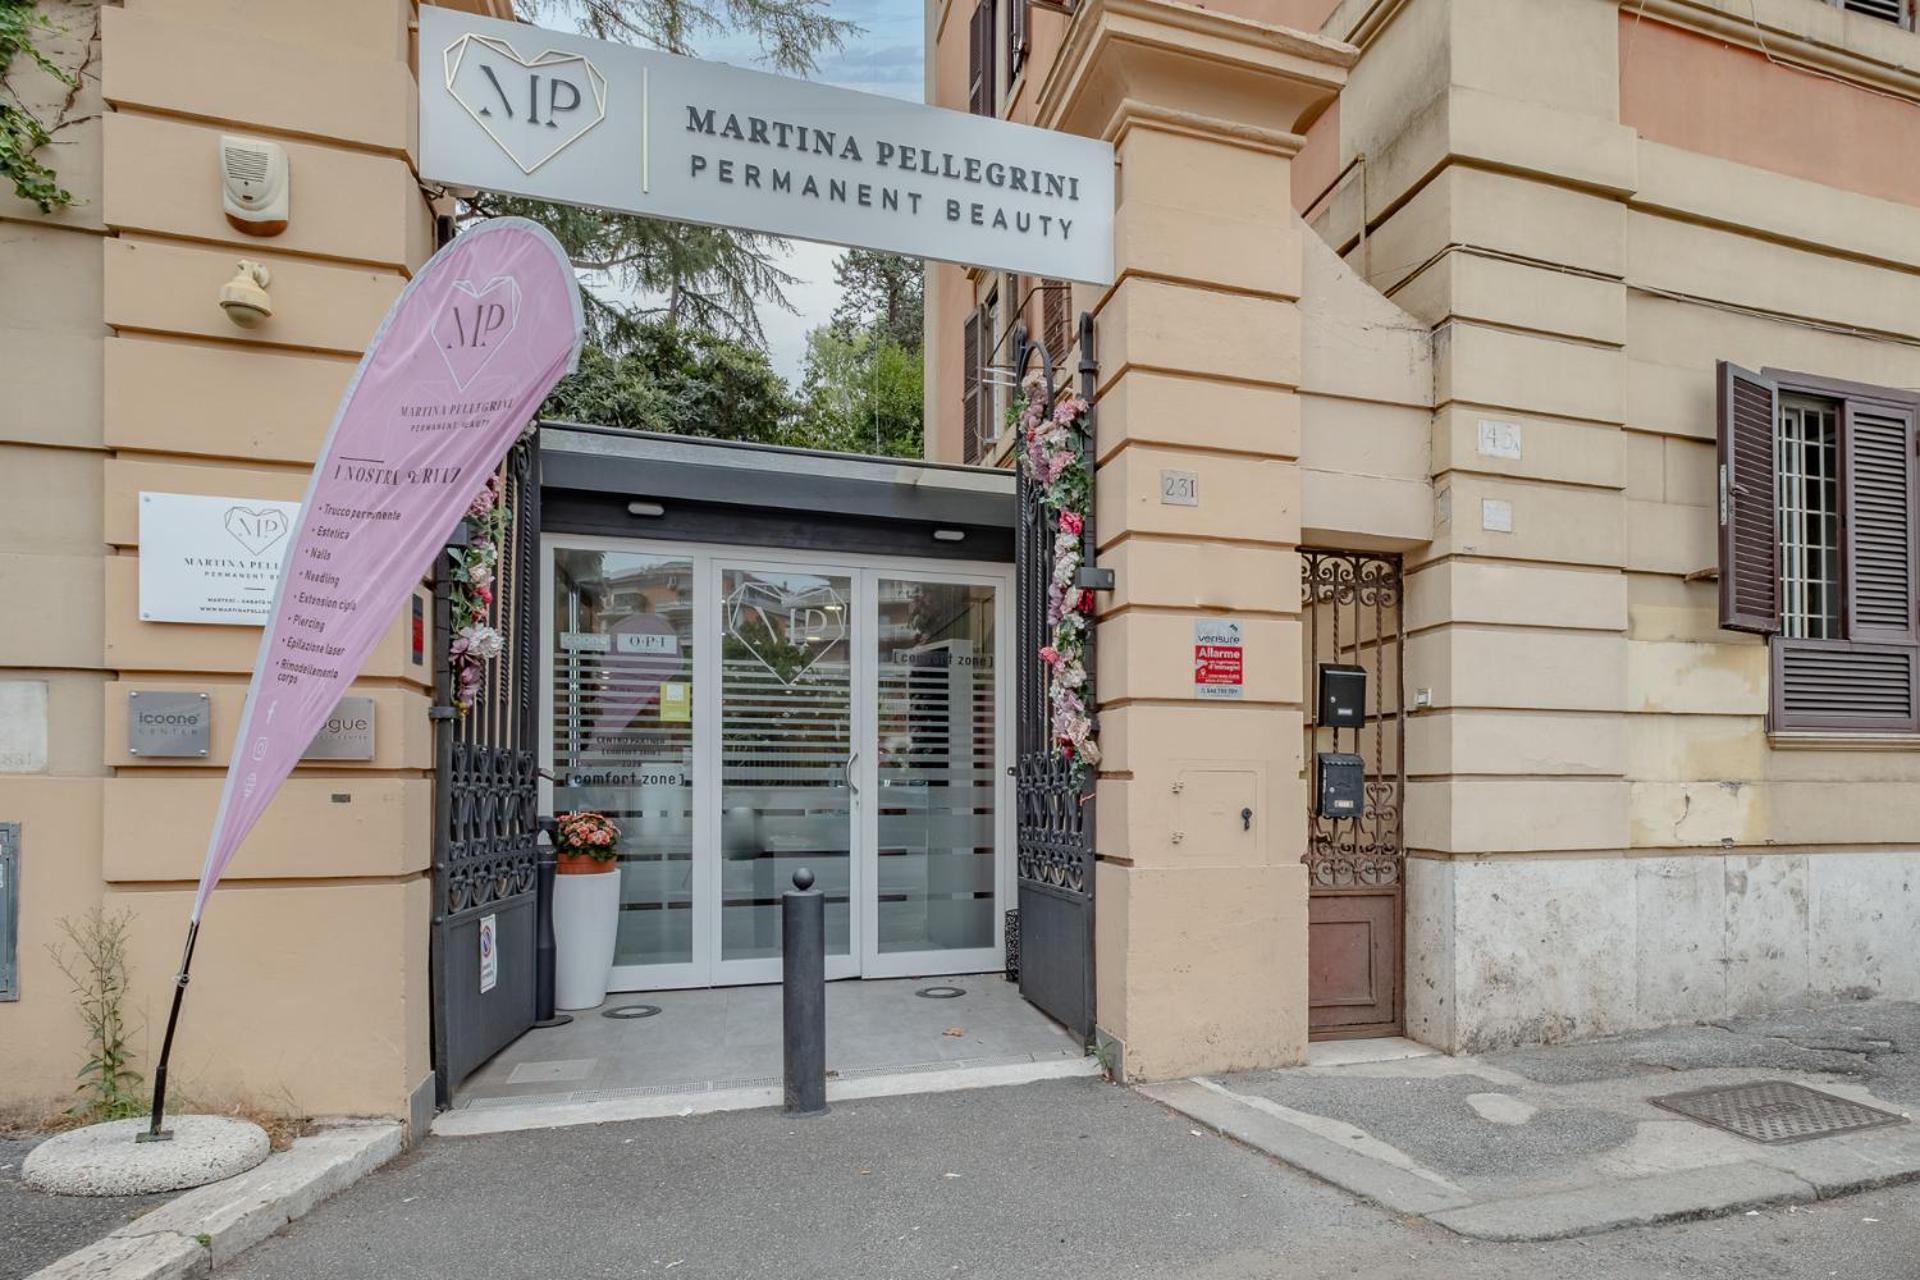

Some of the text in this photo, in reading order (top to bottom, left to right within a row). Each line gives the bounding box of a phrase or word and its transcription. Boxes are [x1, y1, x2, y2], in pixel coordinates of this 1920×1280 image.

[686, 105, 1081, 201] MARTINA PELLEGRINI
[691, 155, 1074, 240] PERMANENT BEAUTY
[1165, 476, 1195, 498] 231
[324, 503, 350, 517] Trucco
[316, 525, 350, 540] Estetica
[310, 547, 332, 560] Nails
[184, 557, 245, 569] MARTINA
[204, 571, 264, 580] PERMANENT
[304, 570, 341, 588] Needling
[298, 592, 338, 609] Extension
[293, 614, 326, 633] Piercing
[286, 636, 346, 656] Epilazione laser
[1197, 635, 1241, 644] verisure
[1199, 646, 1241, 659] Allarme
[139, 711, 198, 725] icoone
